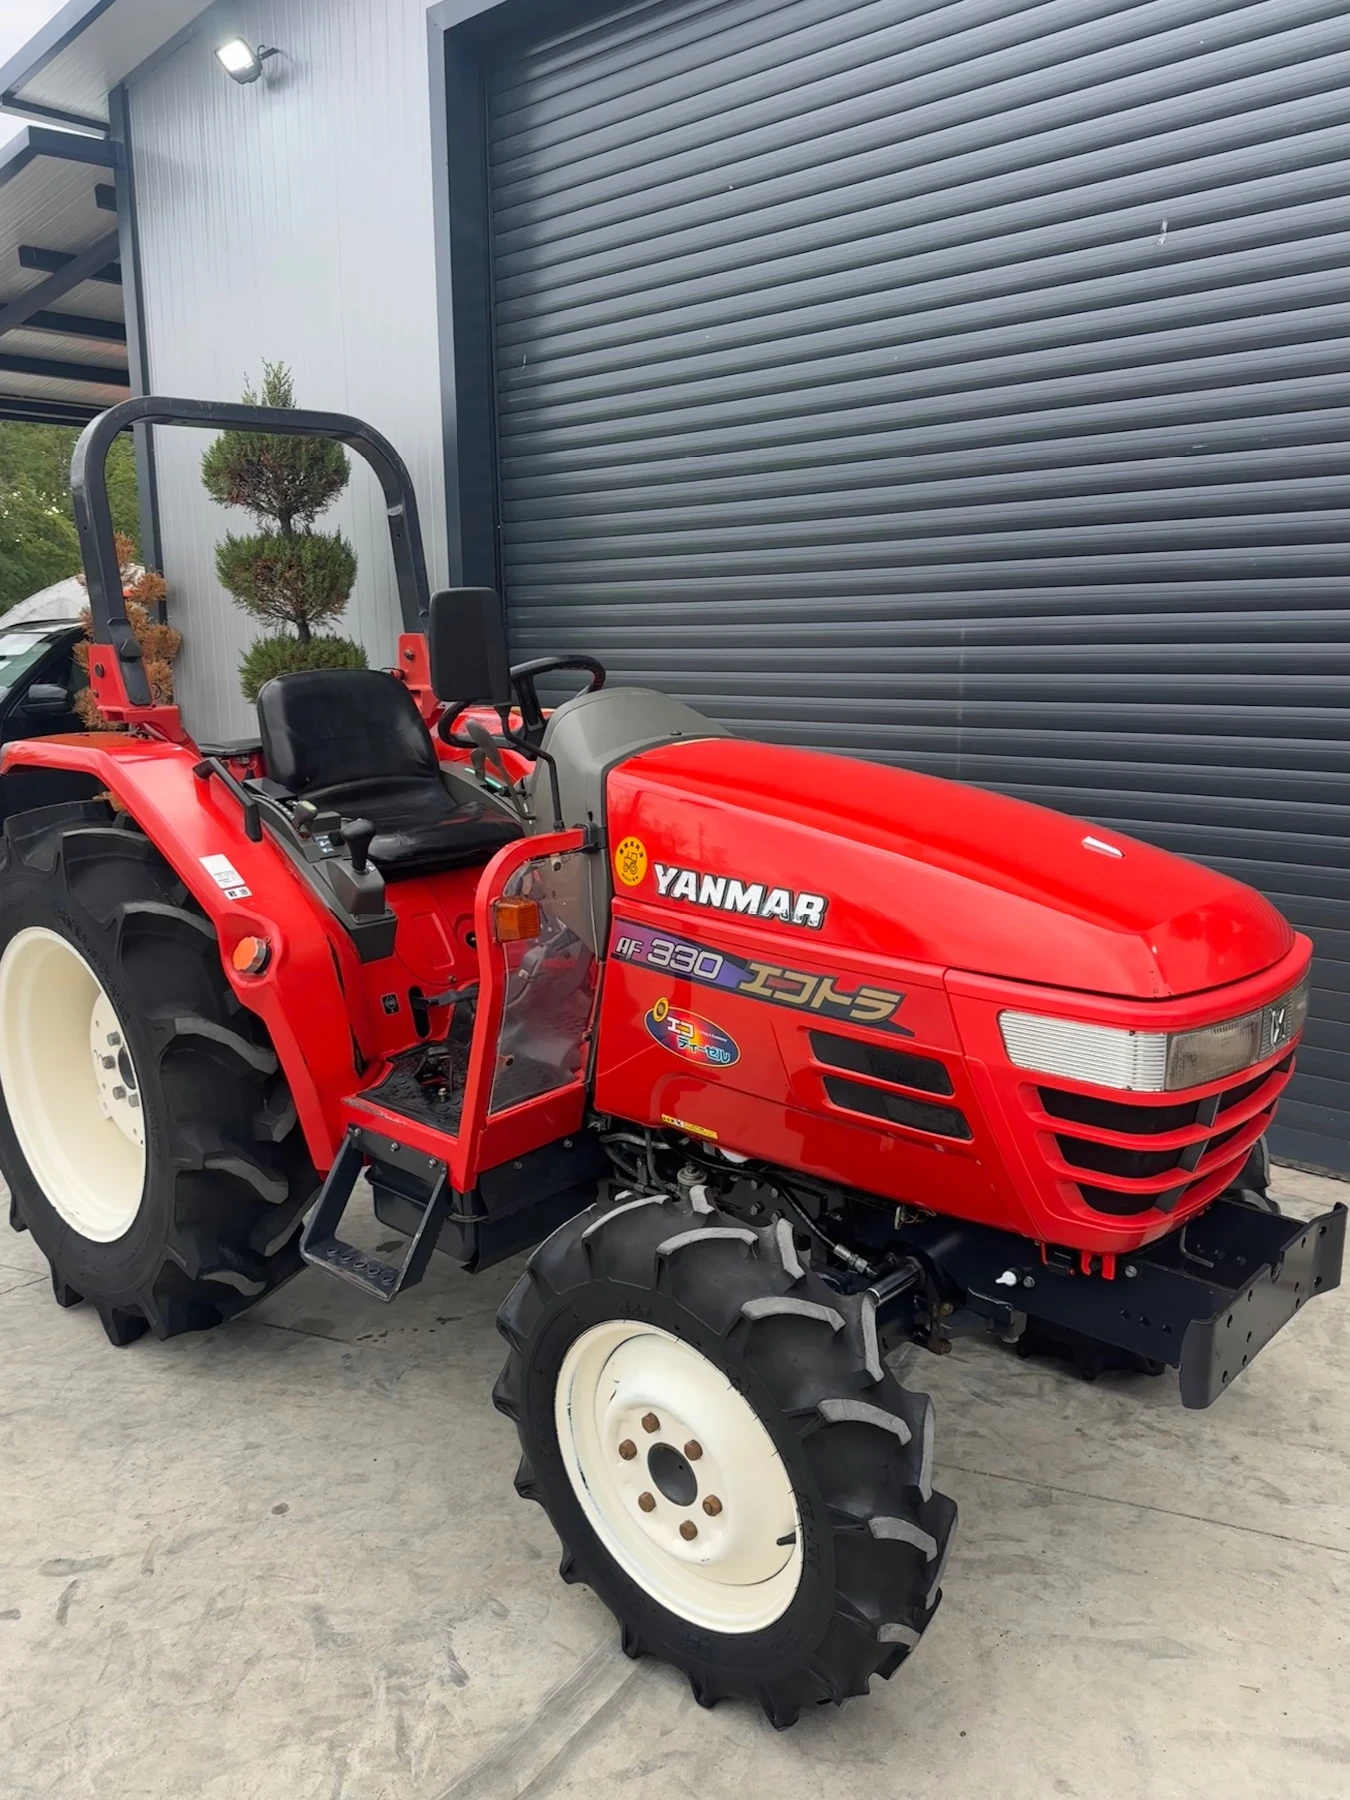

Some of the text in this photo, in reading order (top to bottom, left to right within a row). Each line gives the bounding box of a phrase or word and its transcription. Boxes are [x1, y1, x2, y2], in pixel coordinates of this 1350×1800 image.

[653, 862, 828, 929] YANMAR
[615, 937, 724, 981] AF 330
[738, 961, 902, 1021] エコトラ
[667, 1016, 694, 1038] エコ
